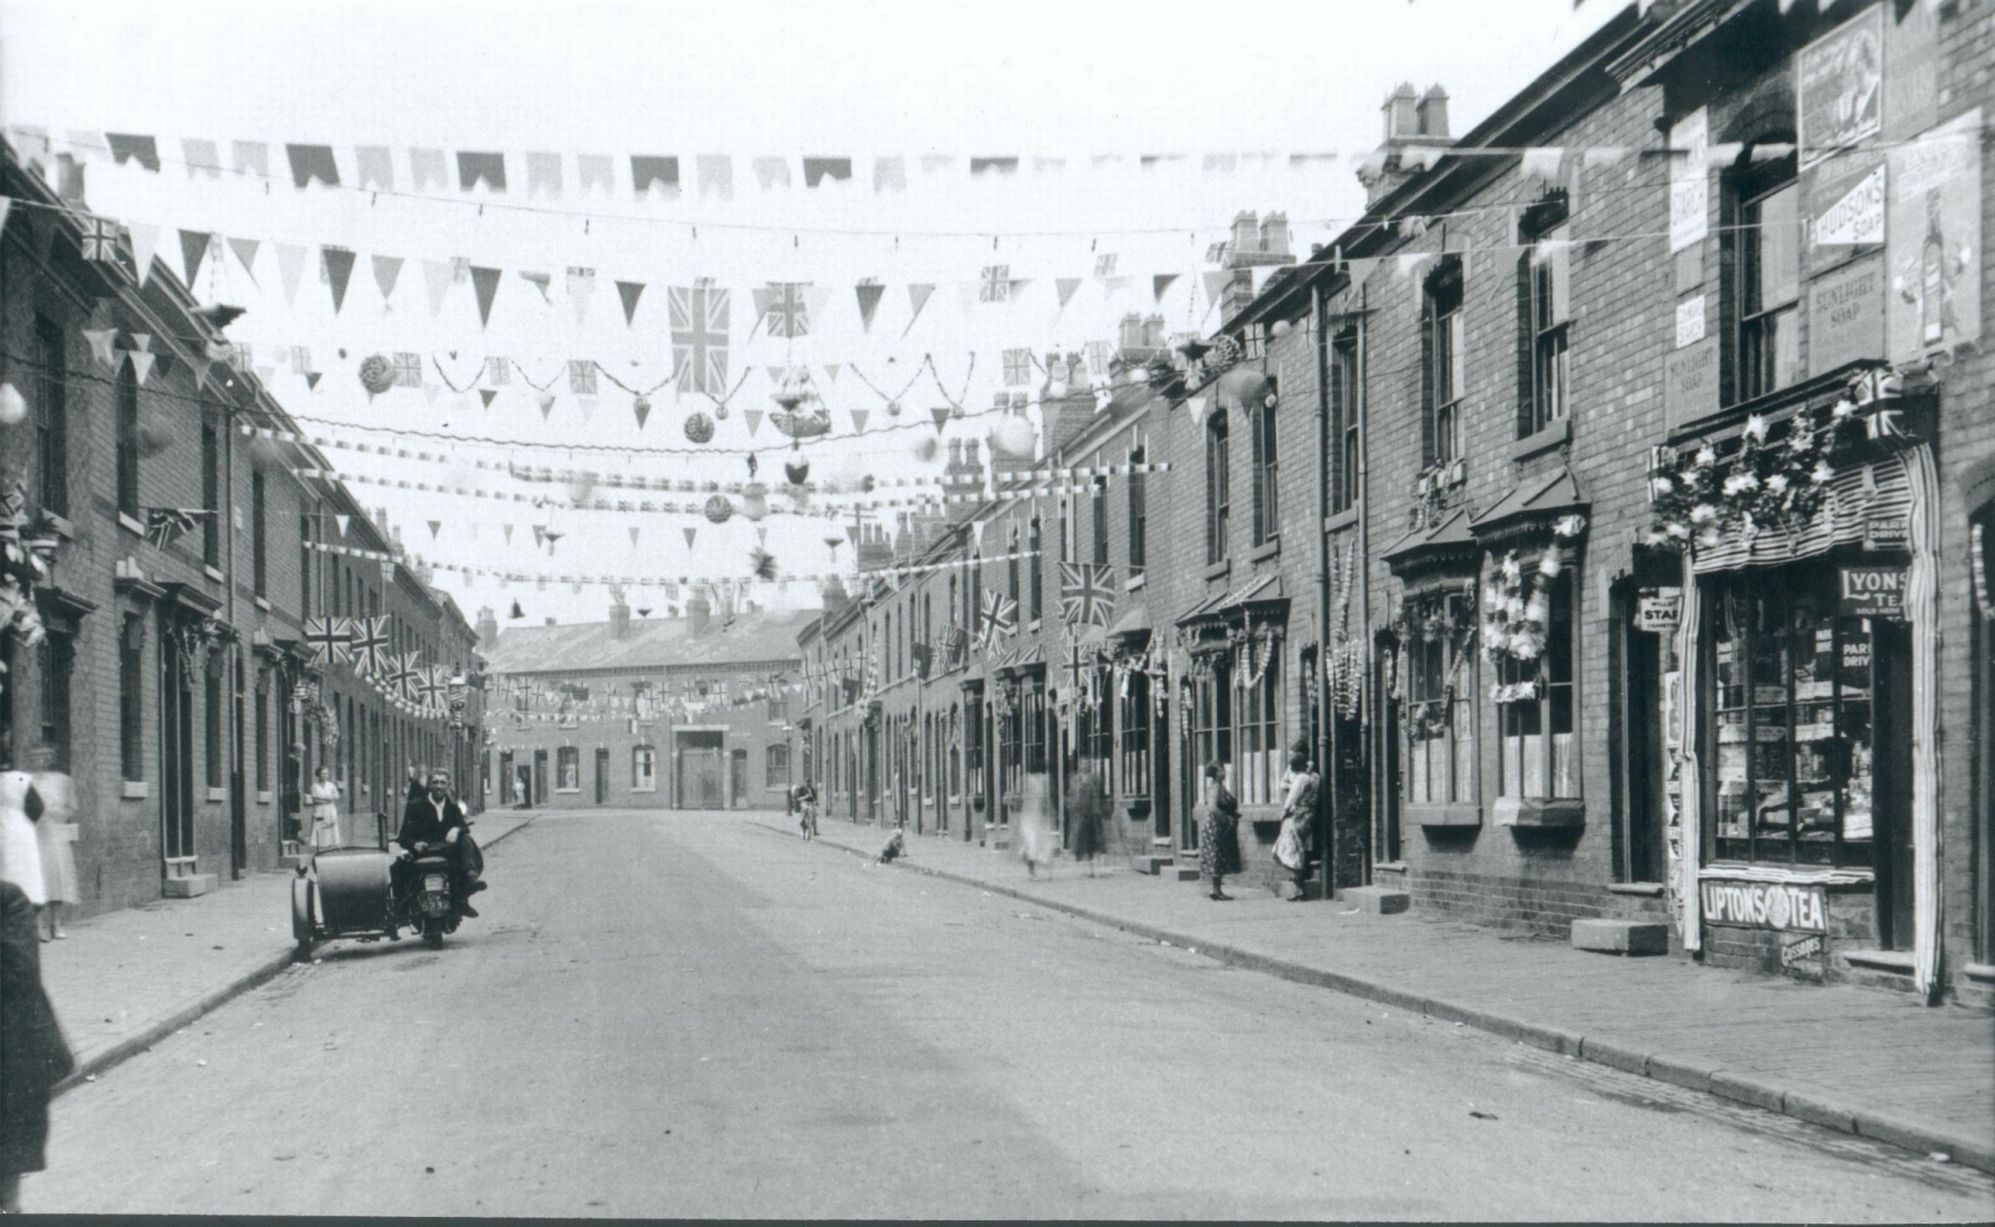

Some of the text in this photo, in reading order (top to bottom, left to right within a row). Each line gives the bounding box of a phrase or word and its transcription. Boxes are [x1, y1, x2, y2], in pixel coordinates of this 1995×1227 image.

[1853, 212, 1883, 241] SOAP
[1816, 271, 1875, 313] SUNLIGHT
[1831, 302, 1861, 328] SOAP
[1680, 371, 1704, 393] SOAP
[1873, 593, 1905, 607] TE
[1842, 655, 1871, 668] DRIV
[1786, 887, 1825, 930] TEA
